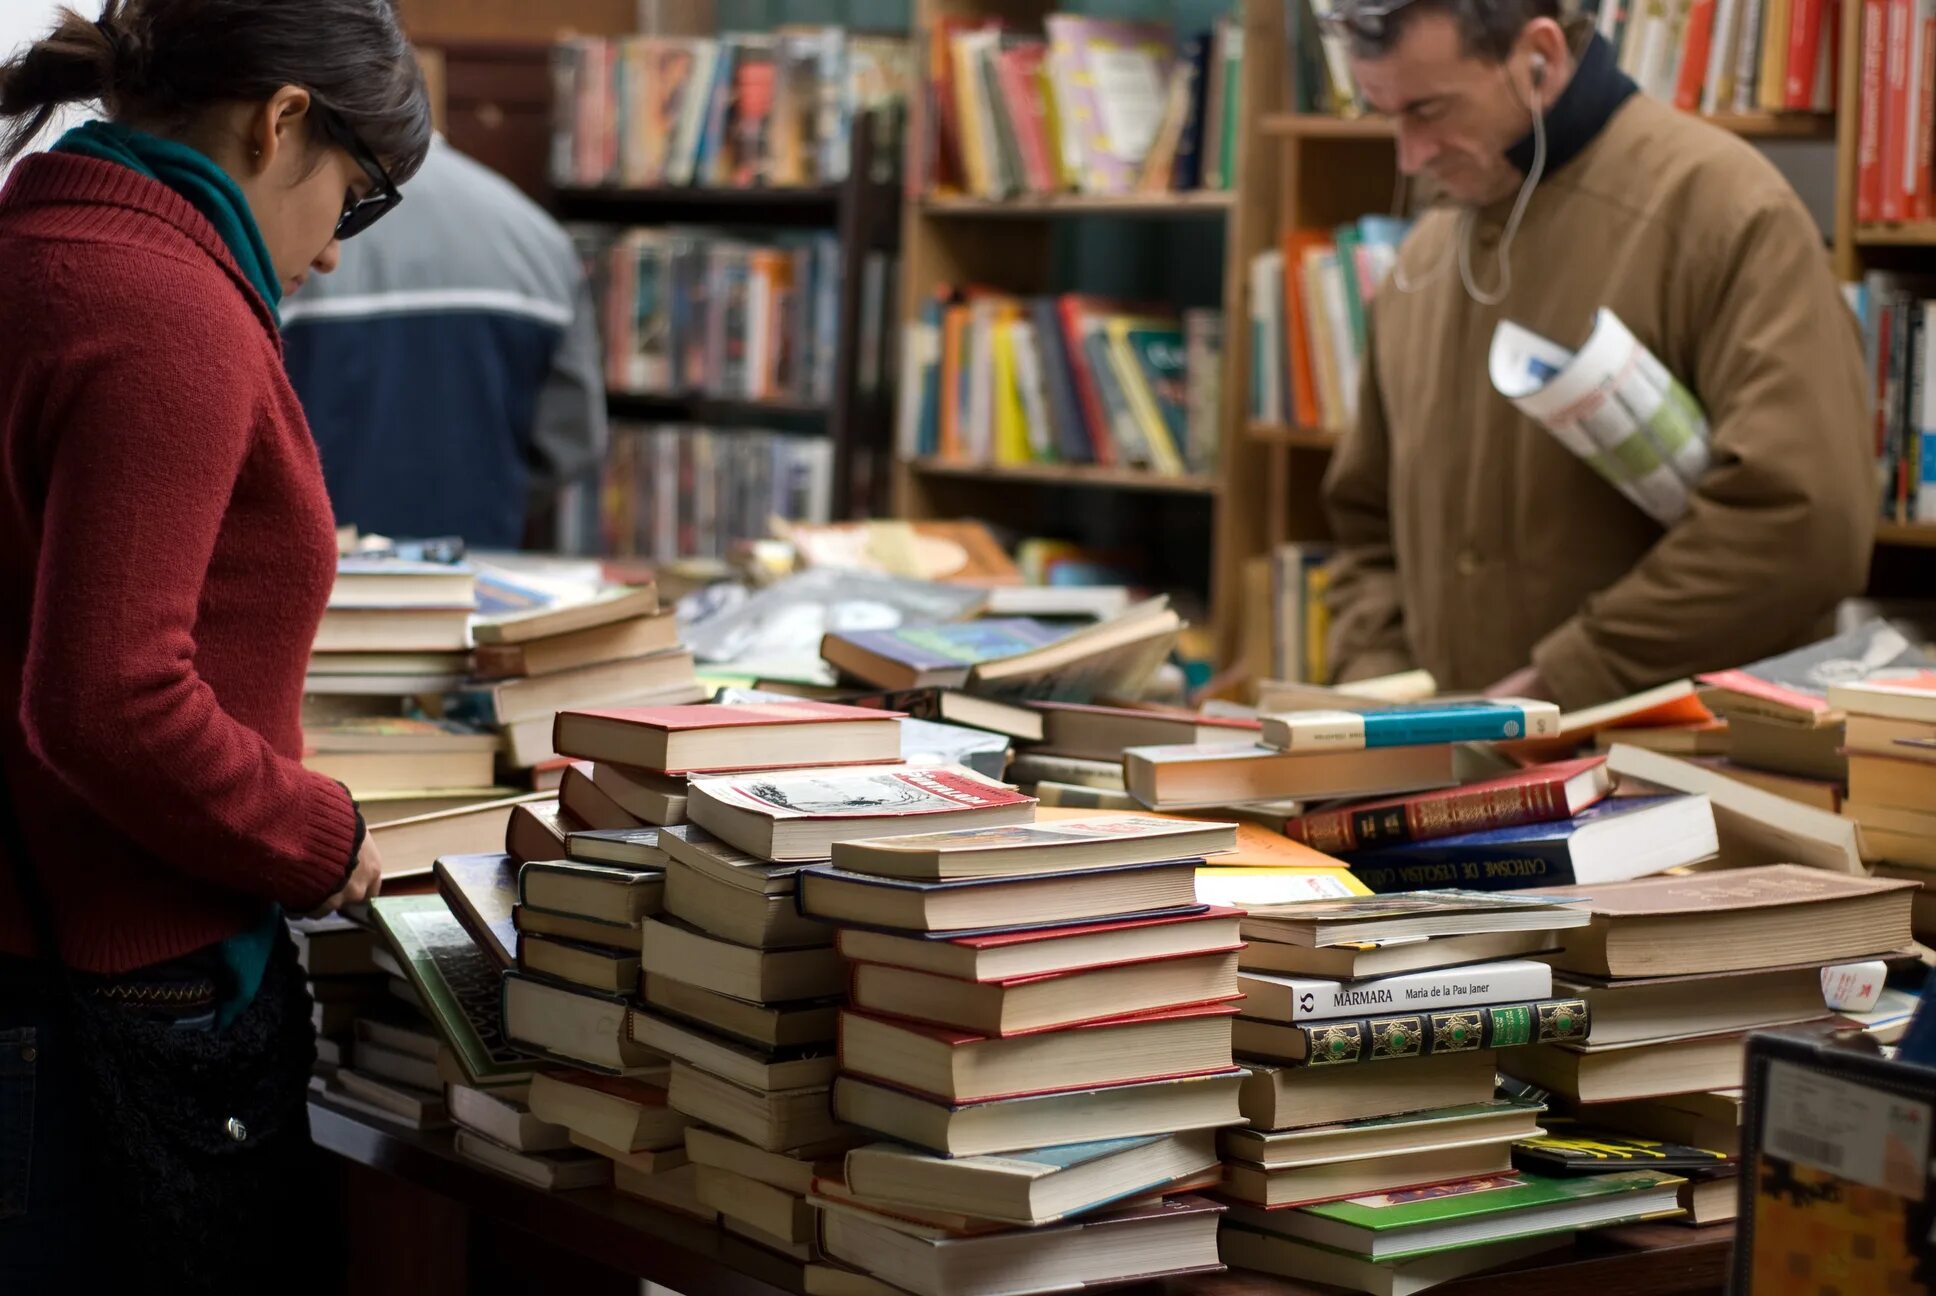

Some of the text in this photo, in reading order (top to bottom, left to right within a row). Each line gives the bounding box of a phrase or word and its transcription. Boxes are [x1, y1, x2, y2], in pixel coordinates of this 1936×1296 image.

[1462, 862, 1479, 878] DE
[1484, 858, 1546, 877] CATECISME
[1333, 989, 1393, 1007] MÀRMARA
[1405, 984, 1489, 999] Maria de la Pau Janer
